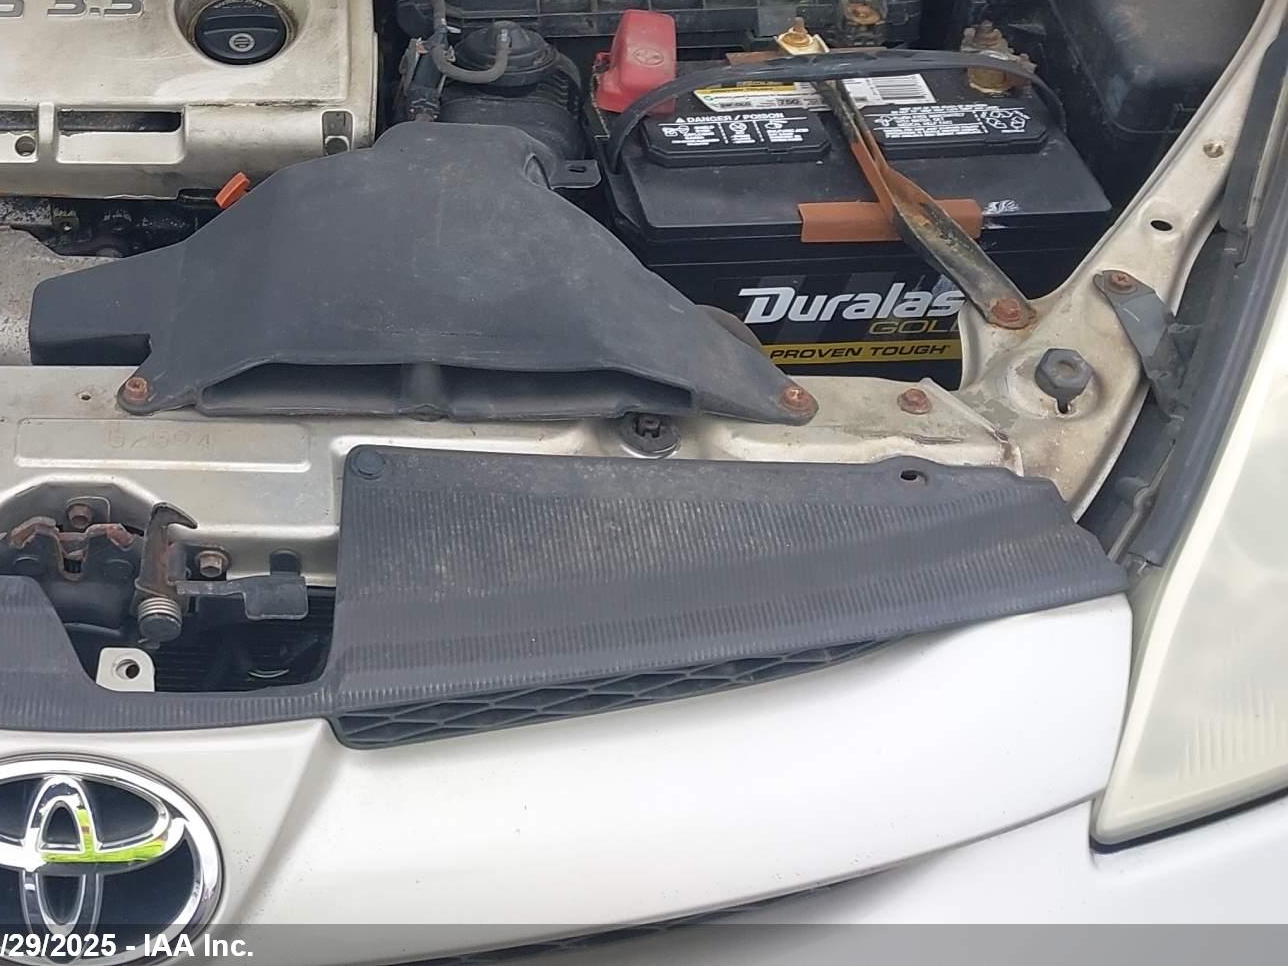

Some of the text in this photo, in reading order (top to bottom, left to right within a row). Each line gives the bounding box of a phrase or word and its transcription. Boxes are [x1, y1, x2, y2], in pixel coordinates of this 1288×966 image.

[686, 114, 732, 123] DANGER
[743, 112, 784, 121] POISON
[738, 283, 966, 324] Duralas
[869, 319, 959, 335] GOL
[769, 346, 862, 360] PROVEN
